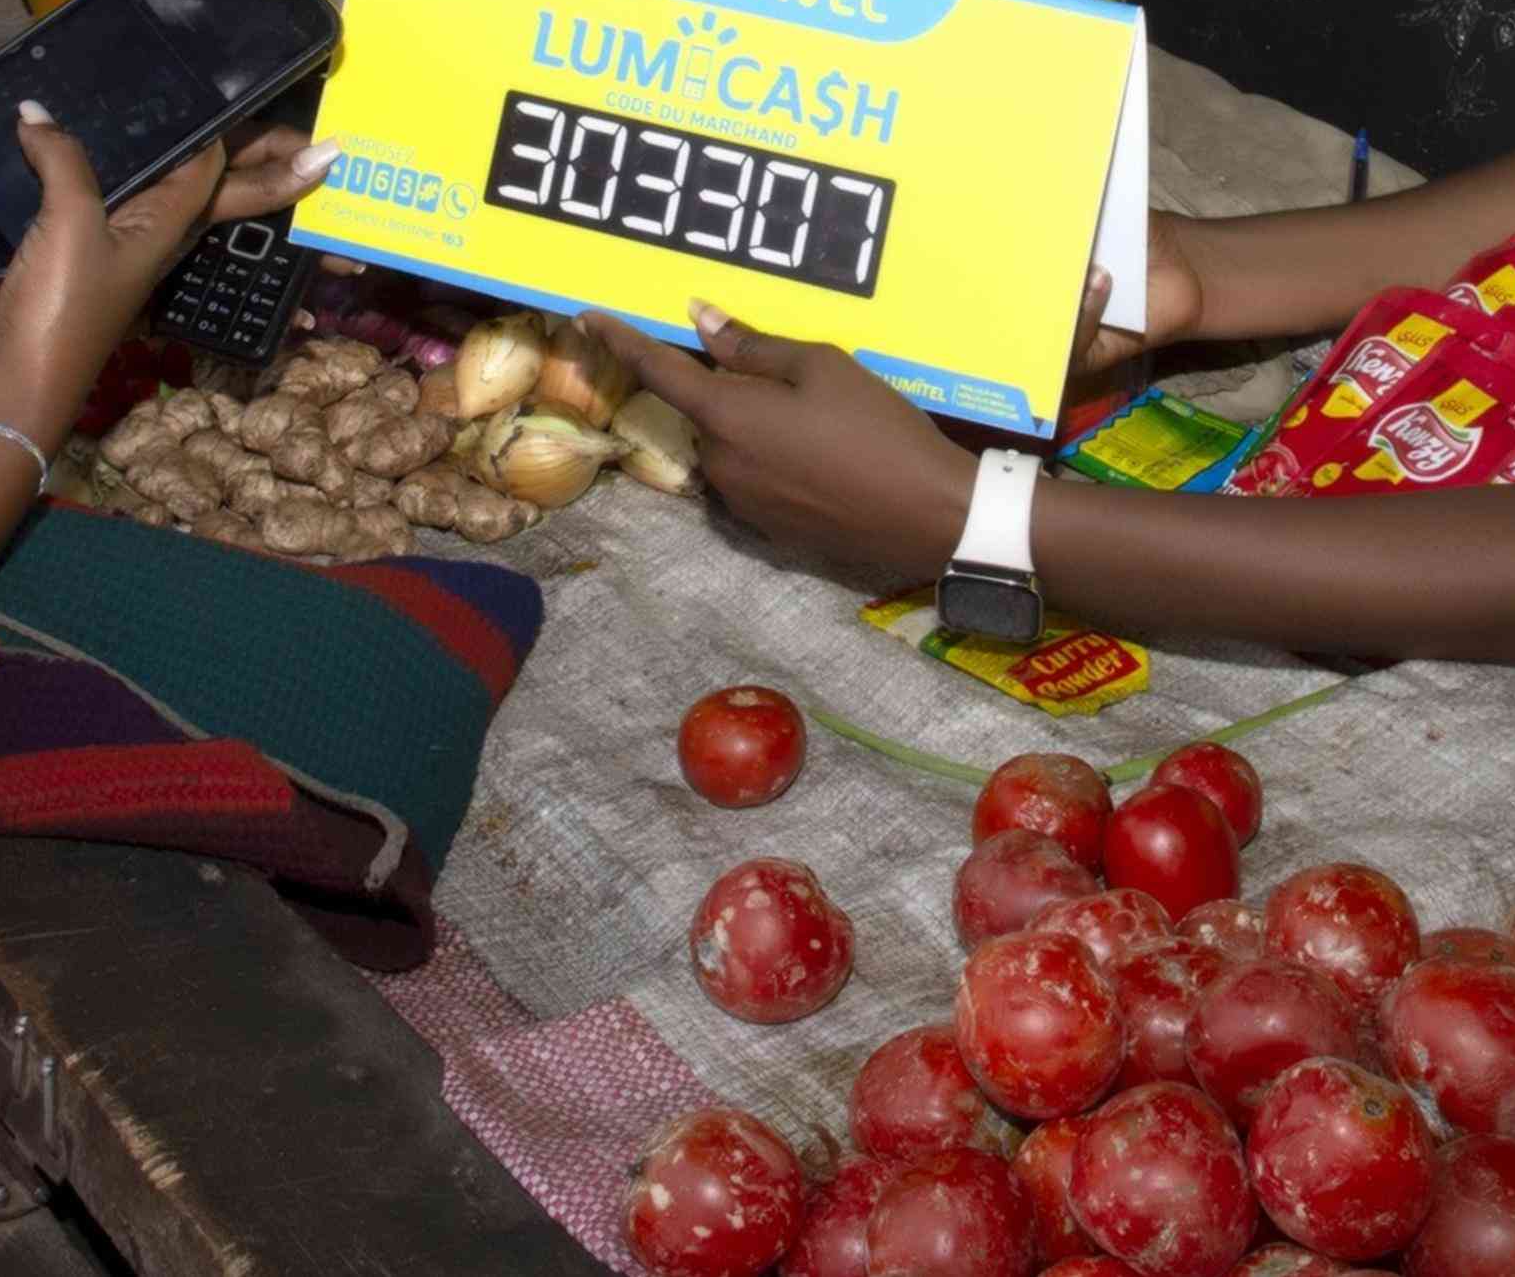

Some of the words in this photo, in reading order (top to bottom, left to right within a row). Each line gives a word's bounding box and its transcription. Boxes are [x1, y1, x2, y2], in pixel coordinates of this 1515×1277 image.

[605, 90, 654, 115] CODE
[659, 104, 685, 124] DU
[689, 111, 798, 151] MARCHAND
[496, 100, 885, 285] 303307
[1386, 409, 1457, 471] Kenzy
[1030, 632, 1110, 676] Curry
[1037, 648, 1126, 699] Powder
